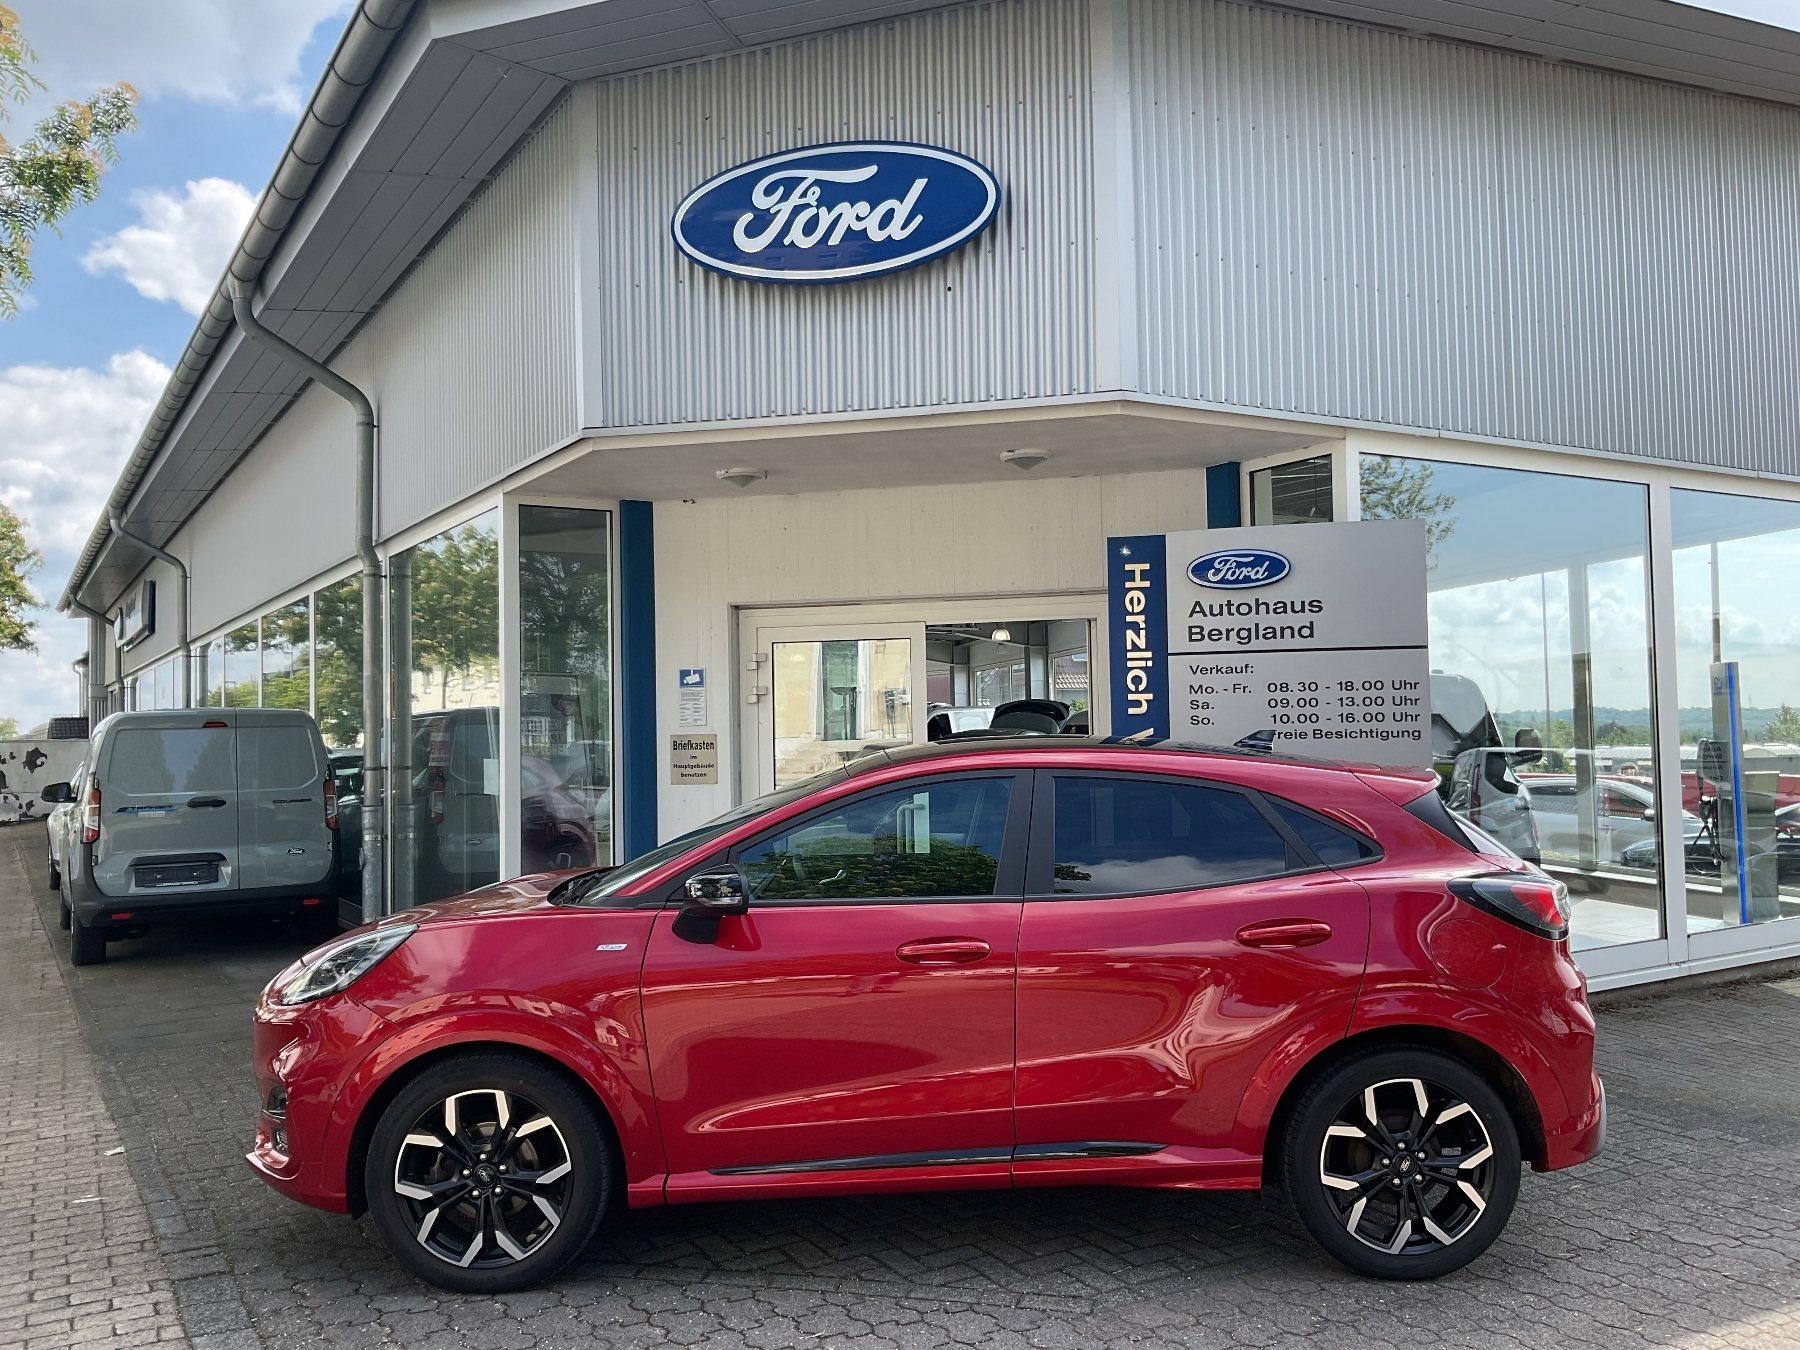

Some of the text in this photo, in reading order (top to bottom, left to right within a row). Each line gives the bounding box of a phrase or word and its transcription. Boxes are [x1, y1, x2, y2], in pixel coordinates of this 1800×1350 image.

[733, 164, 929, 253] Ford
[1207, 556, 1270, 582] Ford
[1188, 597, 1324, 618] Autohaus
[1124, 562, 1154, 715] Herzlich
[1187, 621, 1315, 646] Bergland
[1188, 663, 1254, 676] Verkauf:
[1189, 684, 1219, 695] Mo.
[1232, 683, 1252, 694] Fr.
[1267, 681, 1319, 694] 08.30
[1336, 680, 1385, 692] 18.00
[1391, 679, 1420, 691] Uhr
[1189, 699, 1215, 711] Sa.
[1267, 697, 1319, 709] 09.00
[1336, 696, 1385, 708] 13.00
[1392, 695, 1421, 707] Uhr
[1190, 715, 1215, 726] So.
[1270, 712, 1320, 725] 10.00
[1337, 711, 1386, 723] 16.00
[1392, 711, 1421, 723] Uhr
[1312, 728, 1422, 741] Besichtigung
[672, 739, 715, 751] Briefkasten
